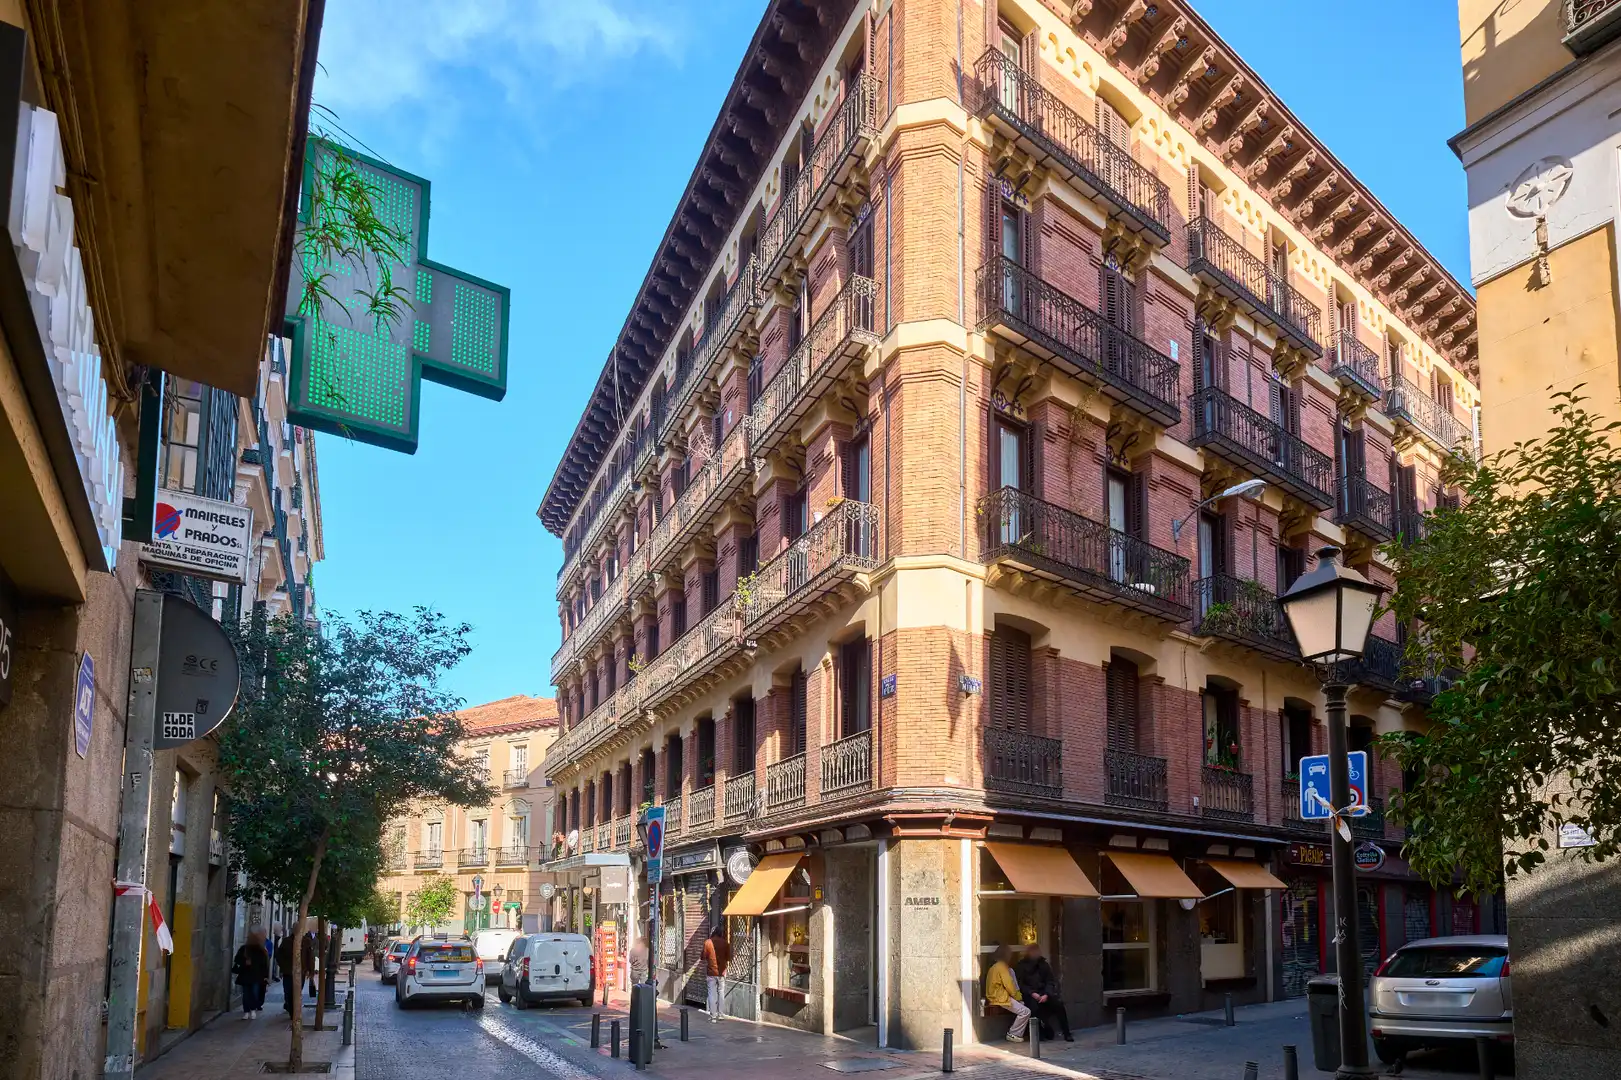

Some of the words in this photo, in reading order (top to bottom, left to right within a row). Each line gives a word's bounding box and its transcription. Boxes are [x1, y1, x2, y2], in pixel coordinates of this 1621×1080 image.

[185, 508, 246, 528] MAIRELES
[184, 528, 237, 548] PRADOS
[141, 546, 187, 560] MAQUINAS
[190, 554, 202, 563] DE
[204, 558, 238, 569] OFICINA
[184, 545, 239, 562] REPARACION
[164, 713, 194, 725] ILDE
[164, 726, 194, 738] SODA
